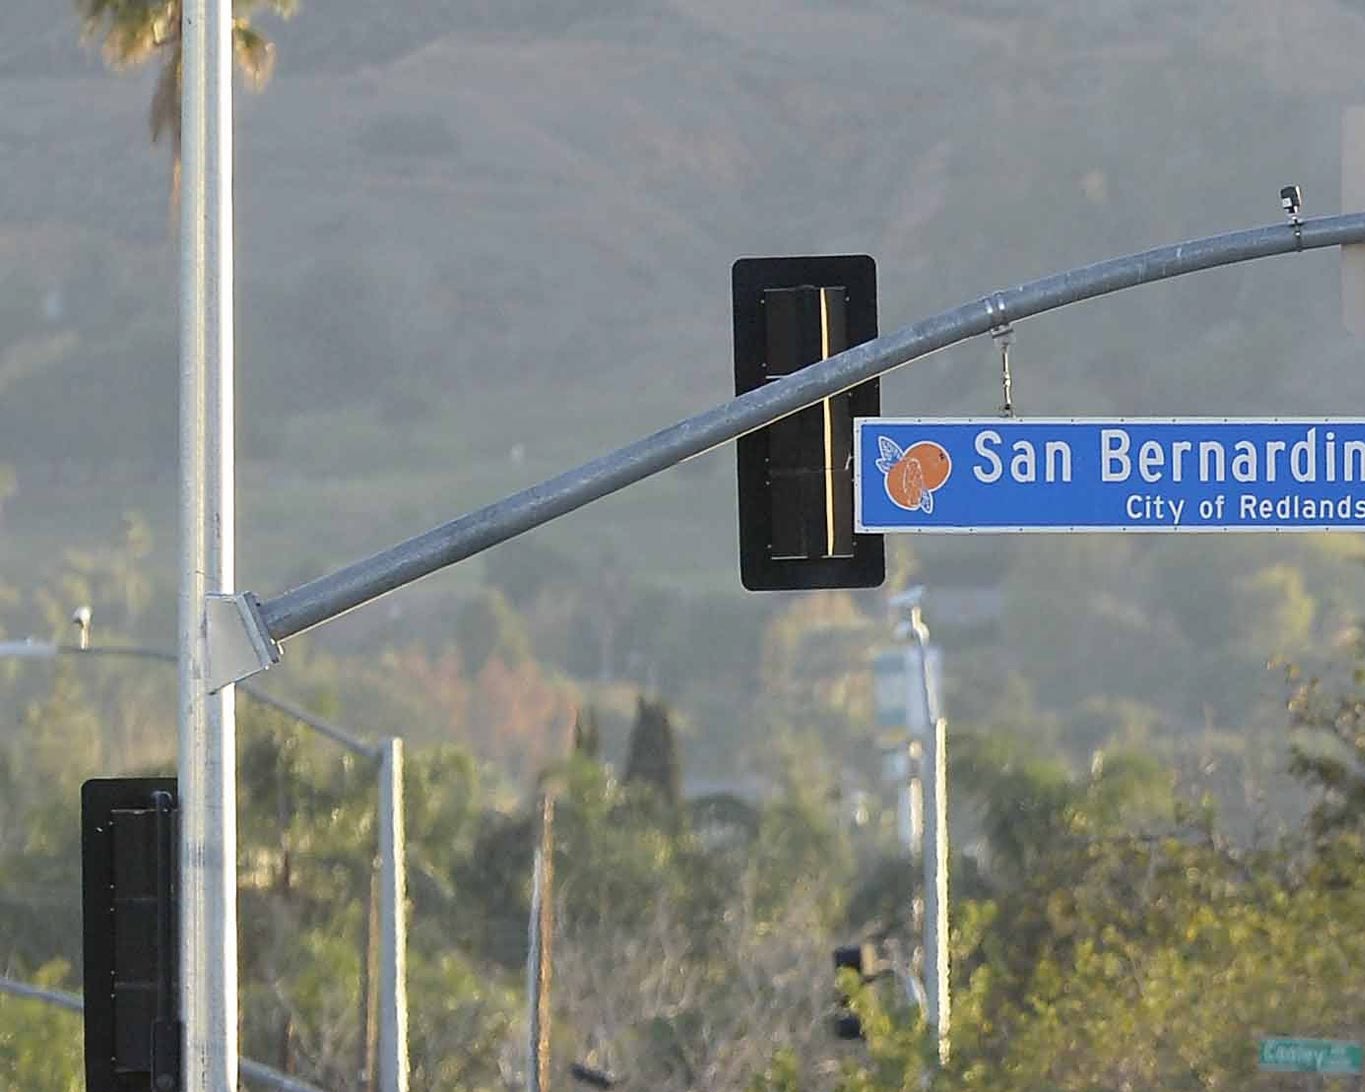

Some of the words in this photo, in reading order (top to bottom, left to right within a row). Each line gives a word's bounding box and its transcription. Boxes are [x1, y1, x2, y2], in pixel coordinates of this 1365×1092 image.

[973, 430, 1072, 484] San
[1126, 494, 1181, 525] City
[1199, 494, 1225, 520] of
